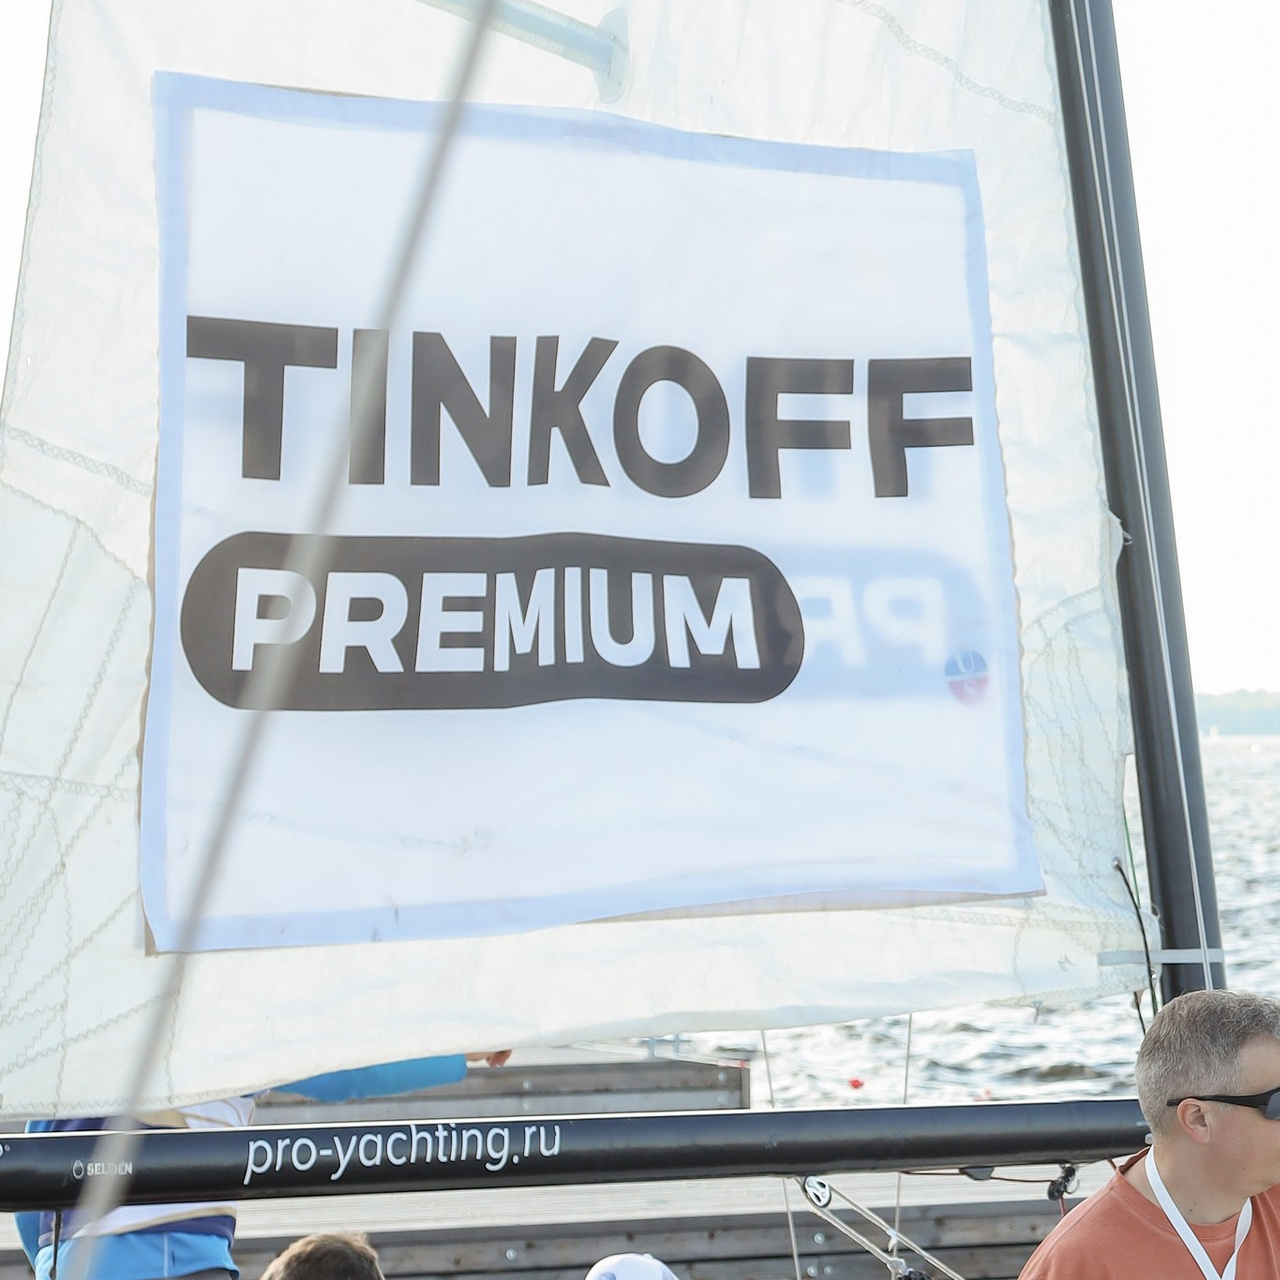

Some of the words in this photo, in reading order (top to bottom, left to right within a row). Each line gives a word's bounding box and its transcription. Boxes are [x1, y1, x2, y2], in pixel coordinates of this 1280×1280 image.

[186, 315, 974, 499] TINKOFF
[231, 566, 760, 674] PREMIUM
[243, 1122, 562, 1186] pro-yachting.ru
